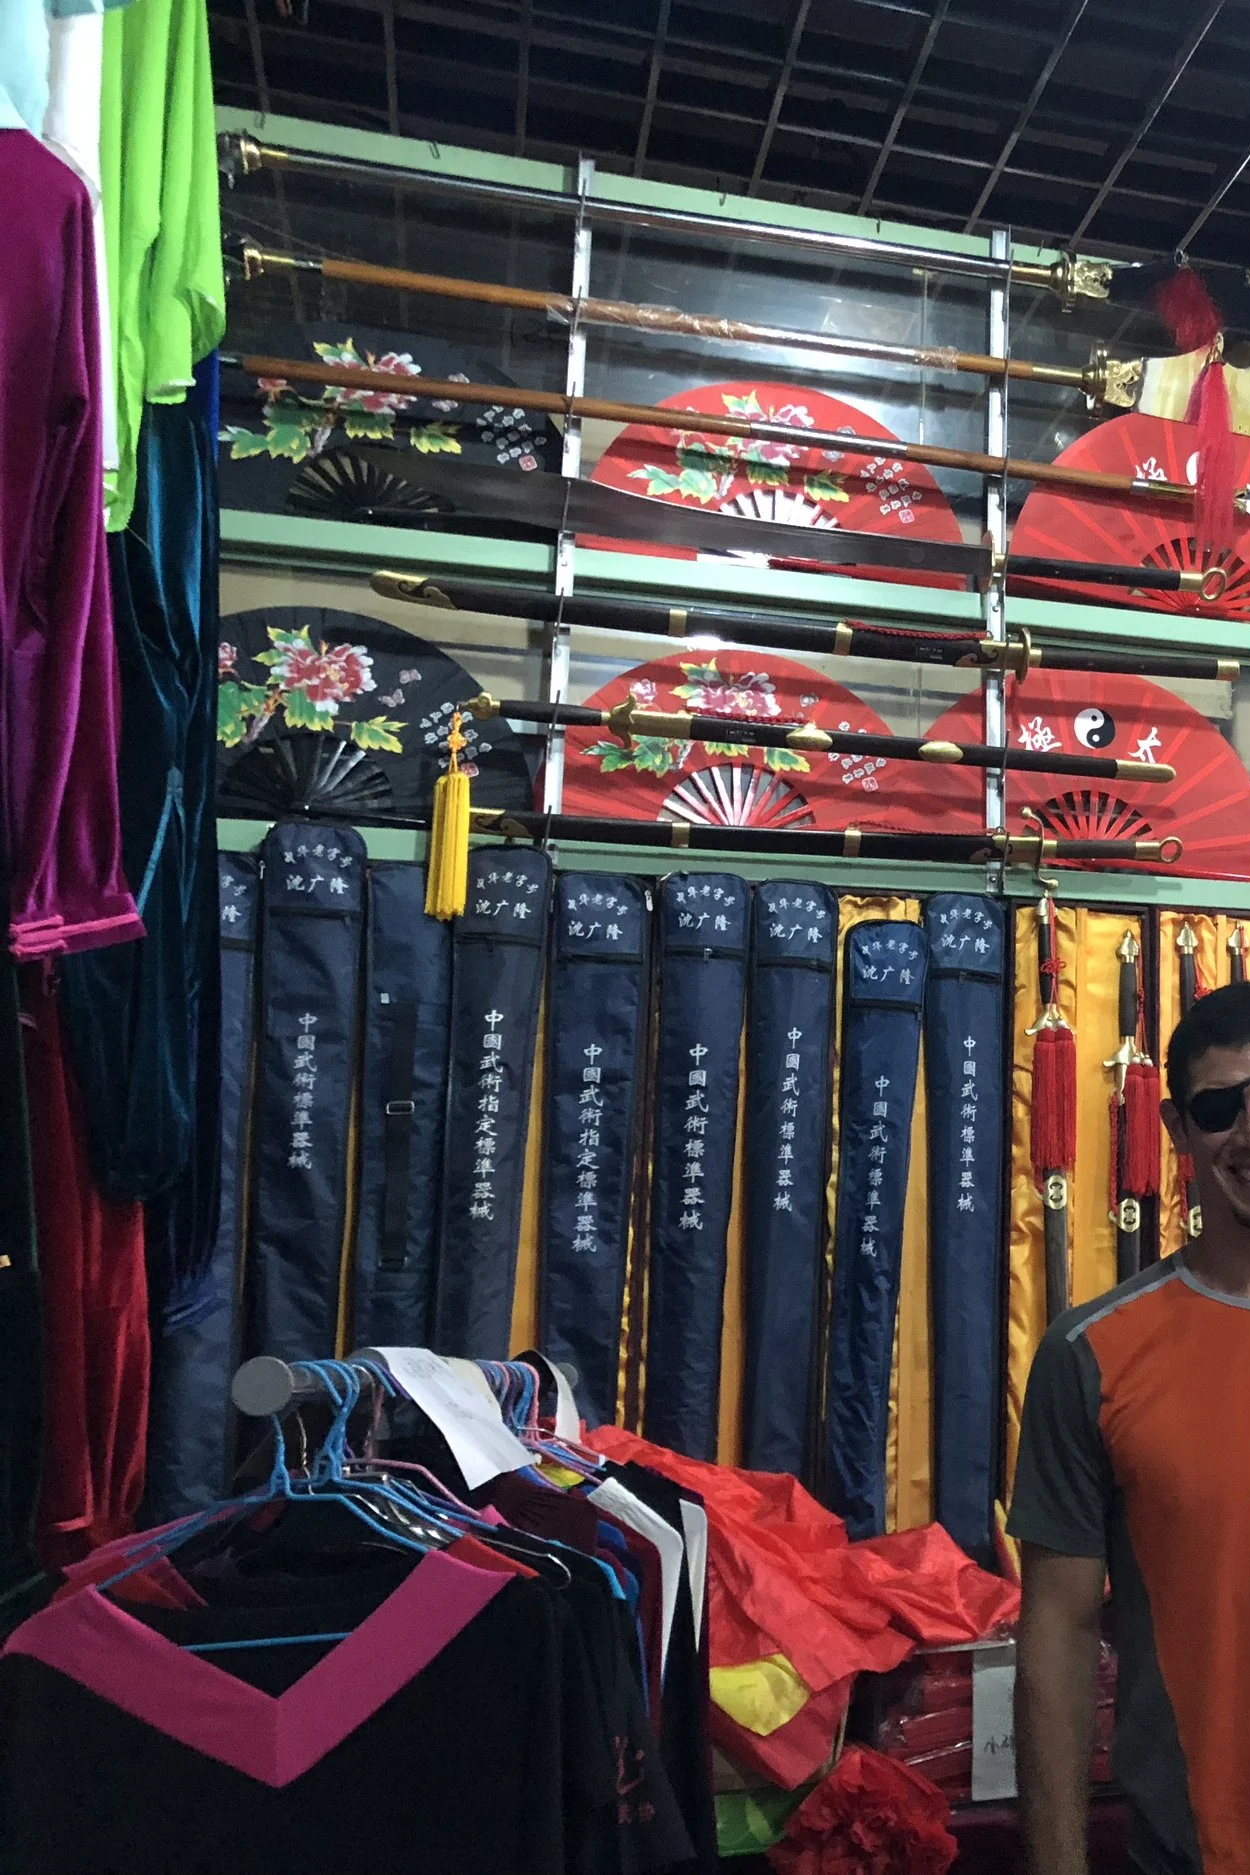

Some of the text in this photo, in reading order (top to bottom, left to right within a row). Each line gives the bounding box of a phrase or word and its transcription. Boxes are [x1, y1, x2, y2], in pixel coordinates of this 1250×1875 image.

[286, 875, 349, 894] 沈广隆
[476, 899, 531, 918] 沈广隆
[569, 921, 623, 940] 沈广隆
[679, 912, 731, 931] 沈广隆
[770, 923, 822, 943] 沈广隆
[942, 934, 990, 953] 沈广隆
[863, 966, 914, 984] 沈广隆
